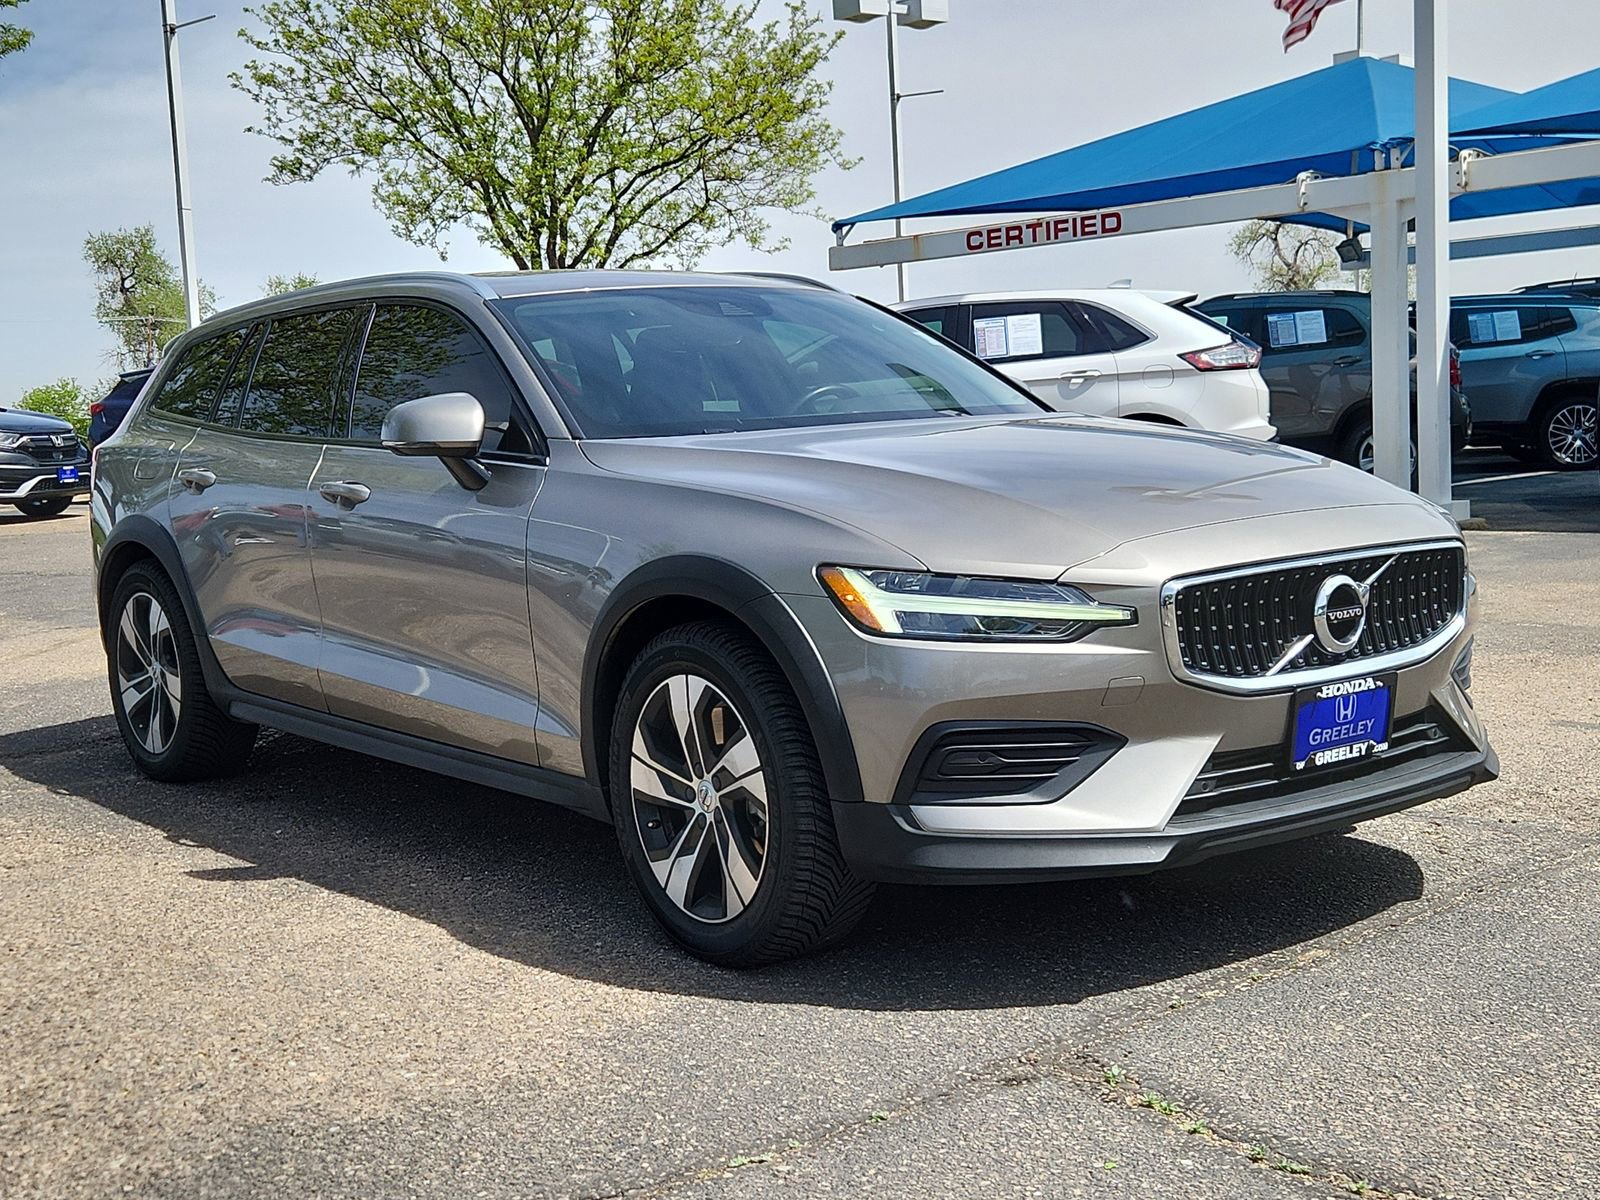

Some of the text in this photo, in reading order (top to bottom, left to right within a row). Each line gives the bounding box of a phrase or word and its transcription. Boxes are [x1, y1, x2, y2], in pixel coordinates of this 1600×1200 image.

[965, 211, 1123, 251] CERTIFIED
[1328, 608, 1362, 620] VOLVO
[1320, 677, 1376, 698] HONDA
[1309, 718, 1375, 746] GREELEY
[1315, 742, 1369, 766] GREELEY
